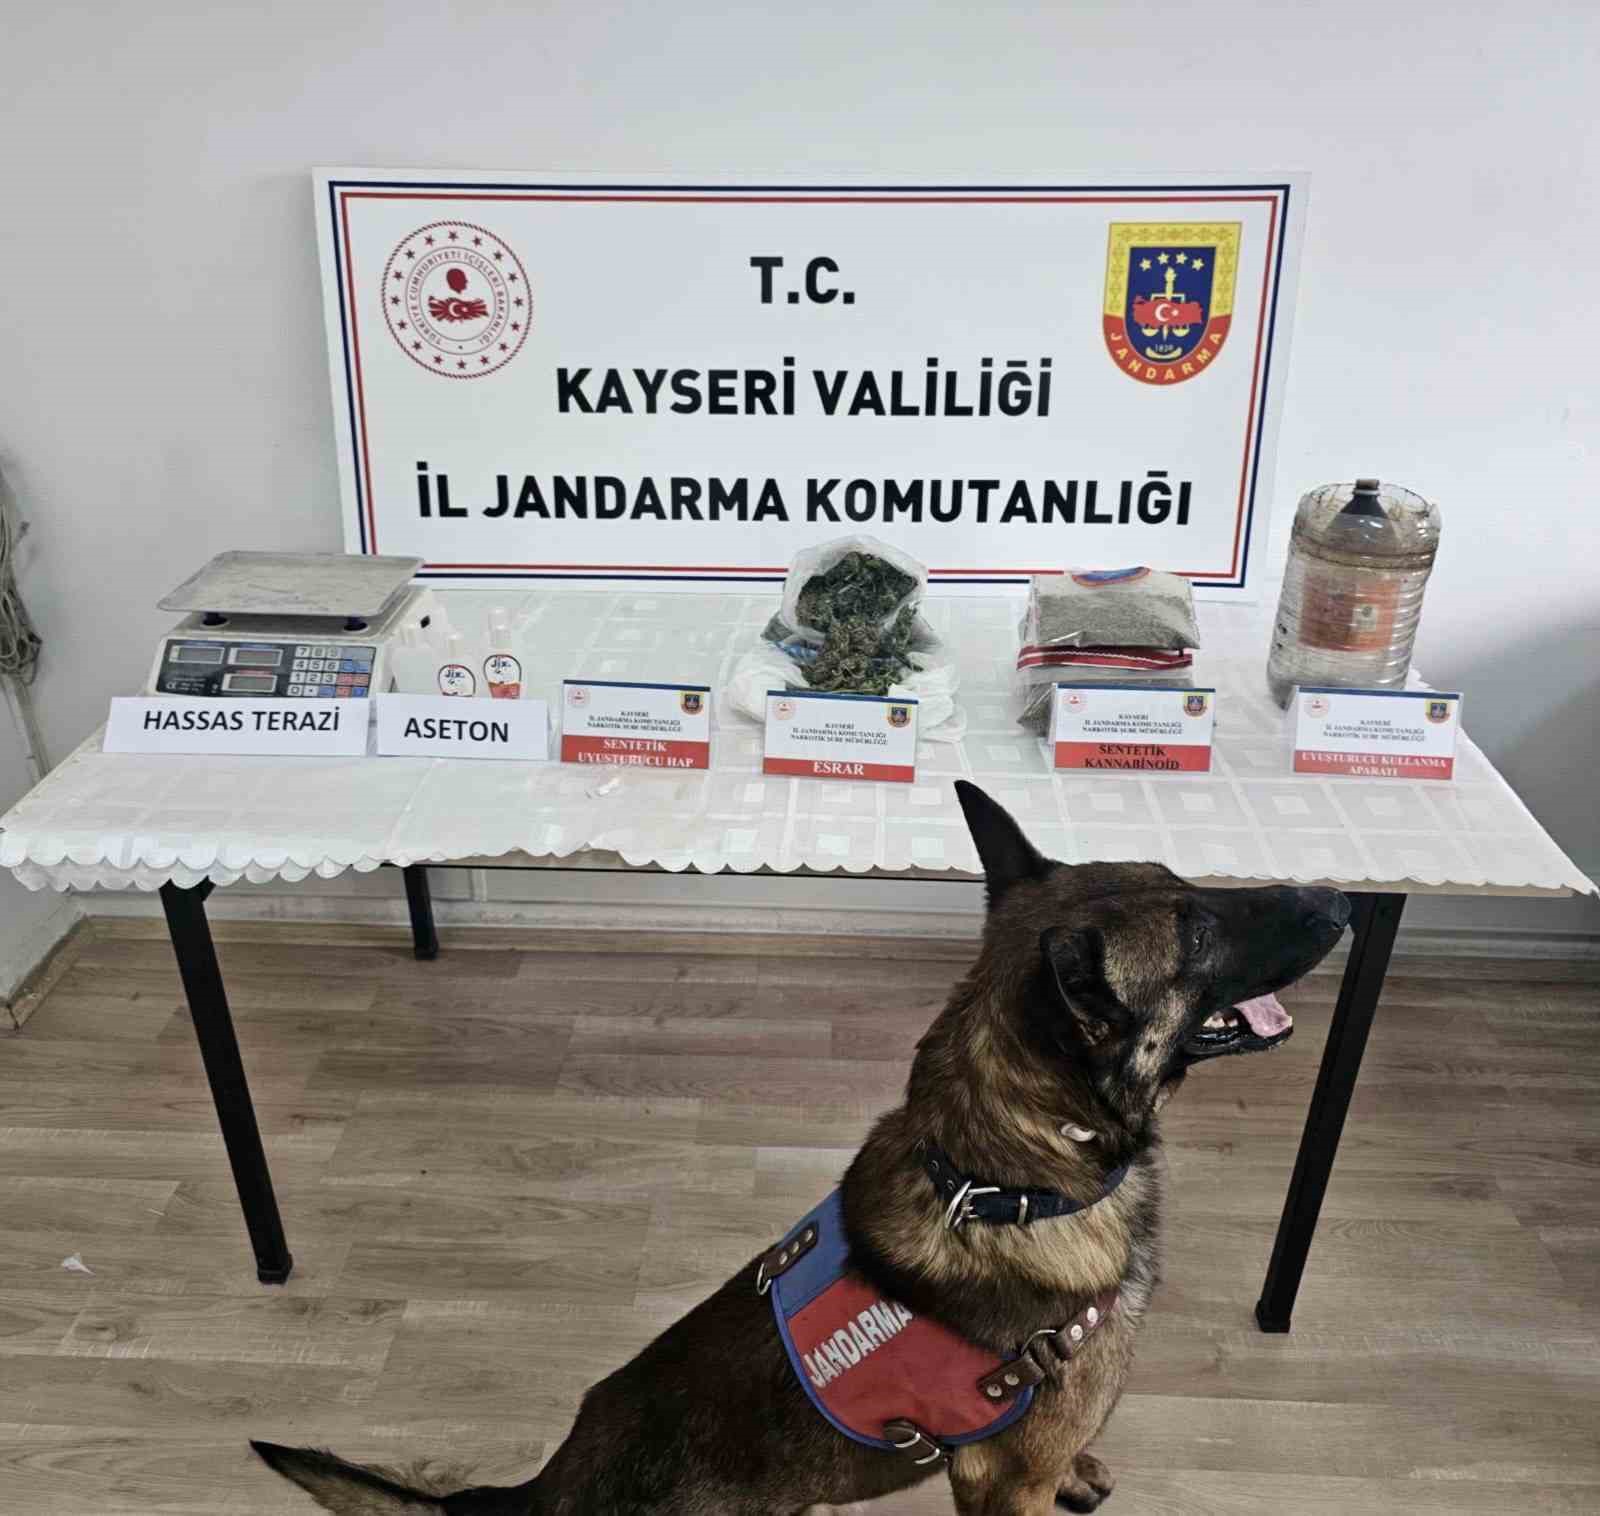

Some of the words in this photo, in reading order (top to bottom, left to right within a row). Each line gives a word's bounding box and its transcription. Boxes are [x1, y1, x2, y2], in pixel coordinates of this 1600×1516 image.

[750, 256, 855, 304] T.C.
[1110, 332, 1222, 380] JANDARMA
[556, 356, 795, 415] KAYSERİ
[813, 357, 1053, 417] VALİLİĞİ
[416, 461, 468, 518] İL
[482, 475, 790, 522] JANDARMA
[806, 470, 1192, 525] KOMUTANLIĞI
[295, 660, 305, 669] 4
[312, 661, 321, 670] 5
[326, 661, 336, 671] 6
[309, 674, 318, 683] 2
[325, 674, 334, 683] 3
[143, 710, 243, 731] HASSAS
[252, 706, 340, 731] TERAZİ
[404, 717, 509, 742] ASETON
[603, 739, 668, 752] SENTETİK
[1098, 744, 1167, 757] SENTETİK
[667, 757, 695, 768] HAP
[813, 760, 865, 776] ESRAR
[1085, 757, 1180, 771] KANNABİNOİD
[1381, 755, 1447, 768] KULLANMA
[1349, 765, 1398, 777] APARATI
[803, 1300, 914, 1388] JANDARMA
